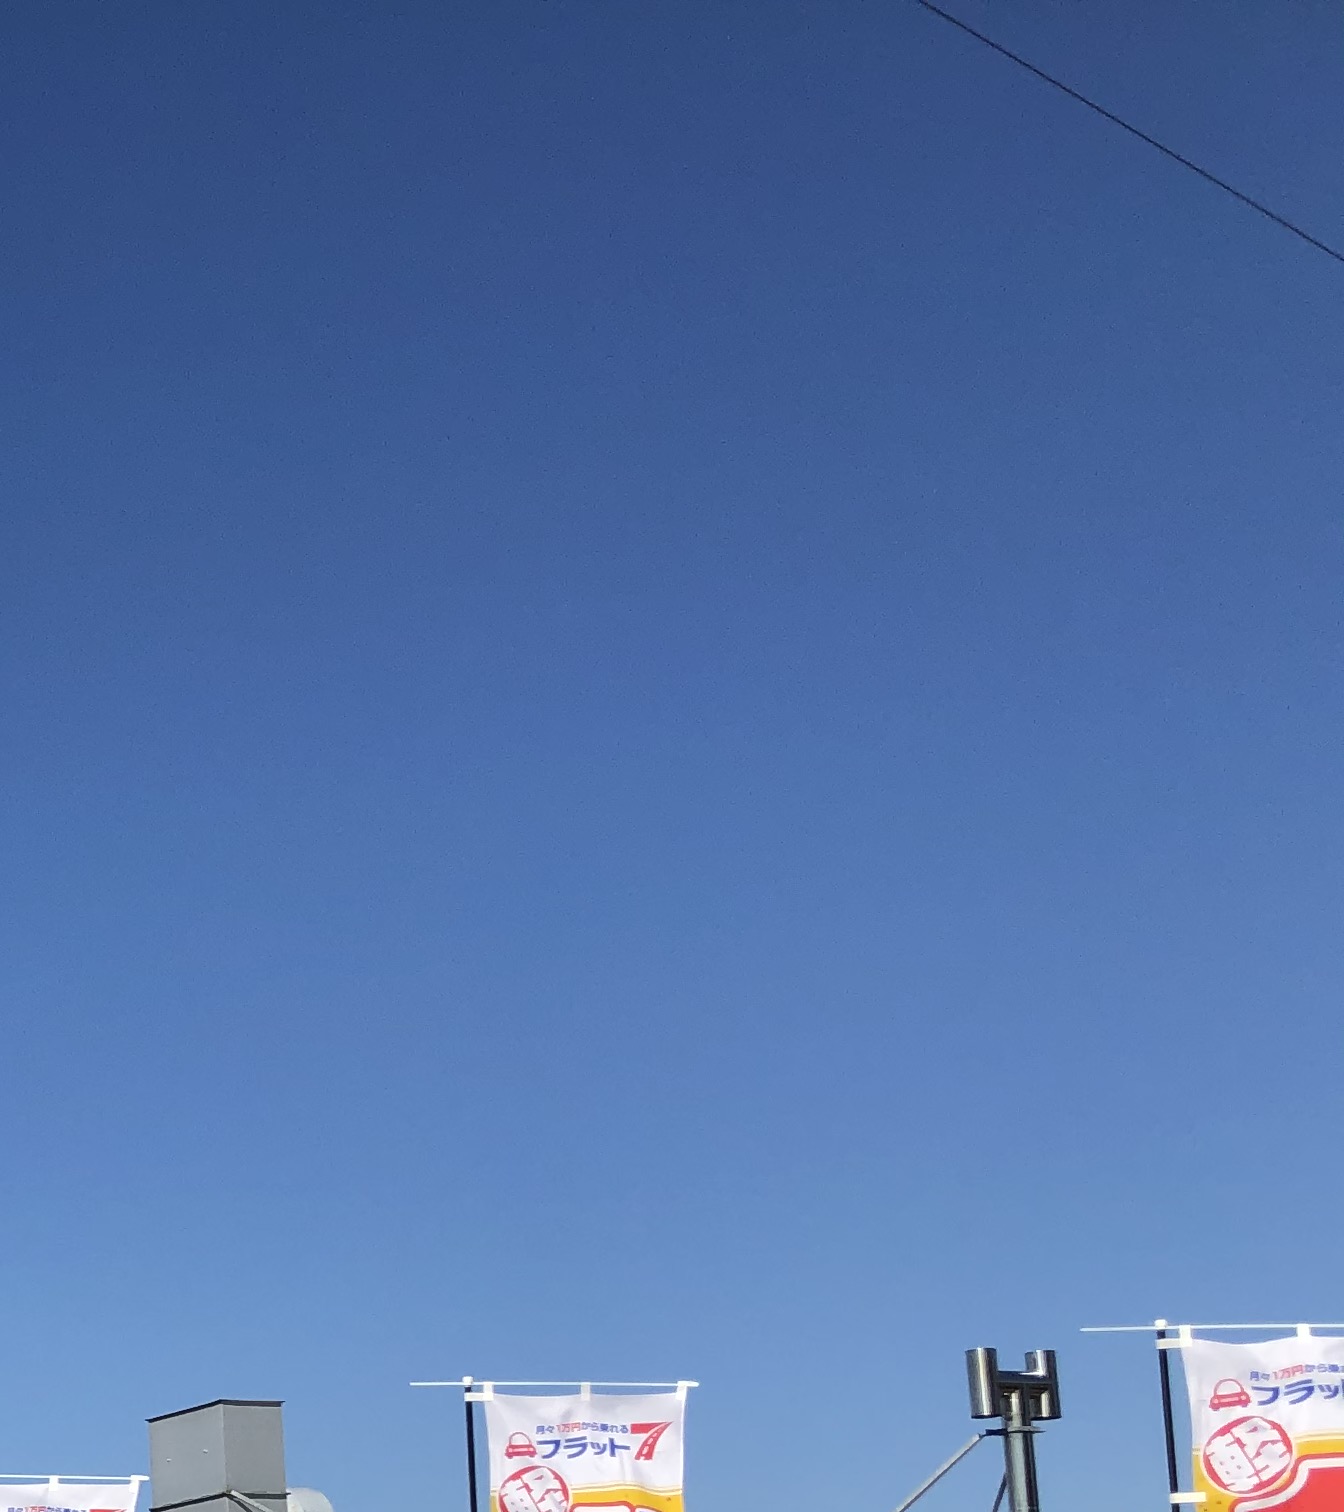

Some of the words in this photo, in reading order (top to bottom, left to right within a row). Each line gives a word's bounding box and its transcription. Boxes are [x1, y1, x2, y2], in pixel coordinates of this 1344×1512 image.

[1251, 1379, 1344, 1406] フラッ
[536, 1422, 629, 1434] 月々1万円から乗れる
[537, 1421, 674, 1461] フラット7
